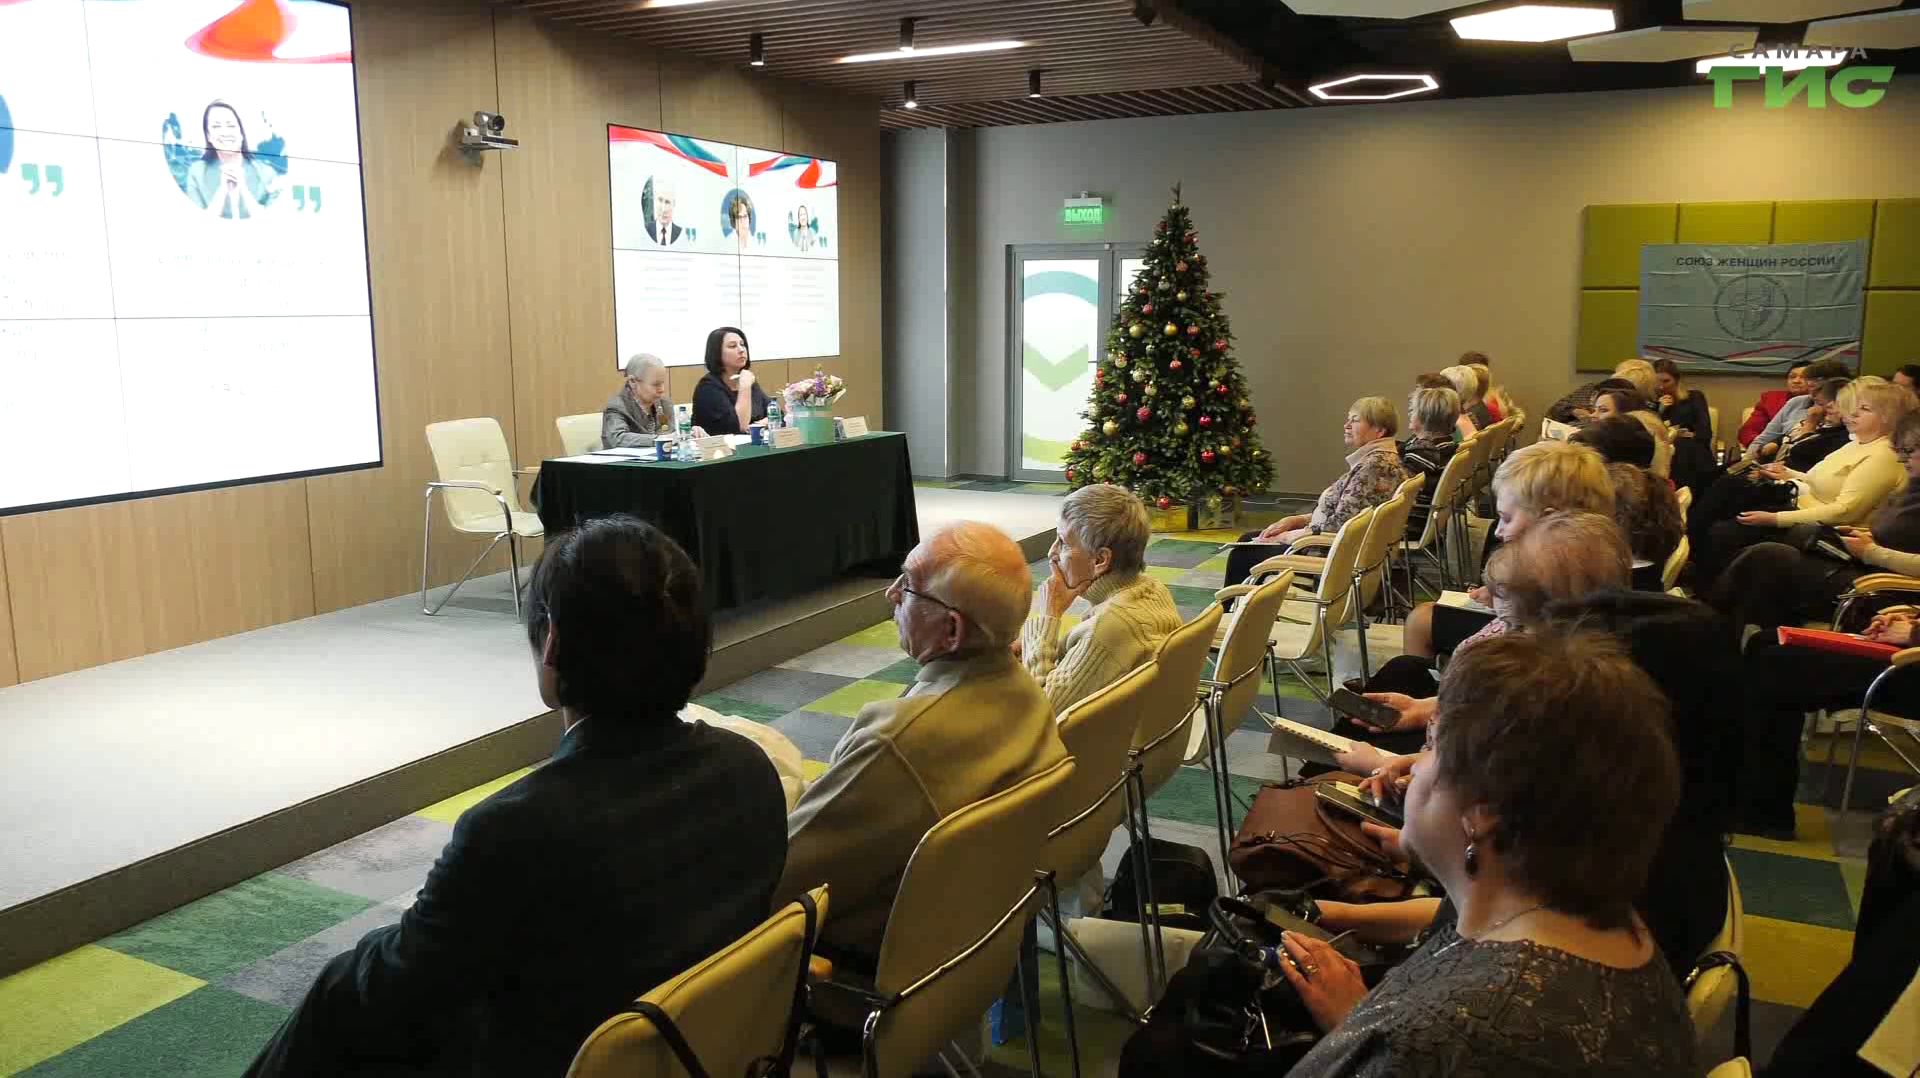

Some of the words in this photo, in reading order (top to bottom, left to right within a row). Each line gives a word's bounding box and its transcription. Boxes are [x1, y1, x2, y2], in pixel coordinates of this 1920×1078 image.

[1064, 208, 1101, 224] ВЫХОД
[1676, 256, 1713, 267] СОЮЗ
[1717, 257, 1777, 268] ЖЕНЩИН
[1781, 255, 1836, 267] РОССИИ
